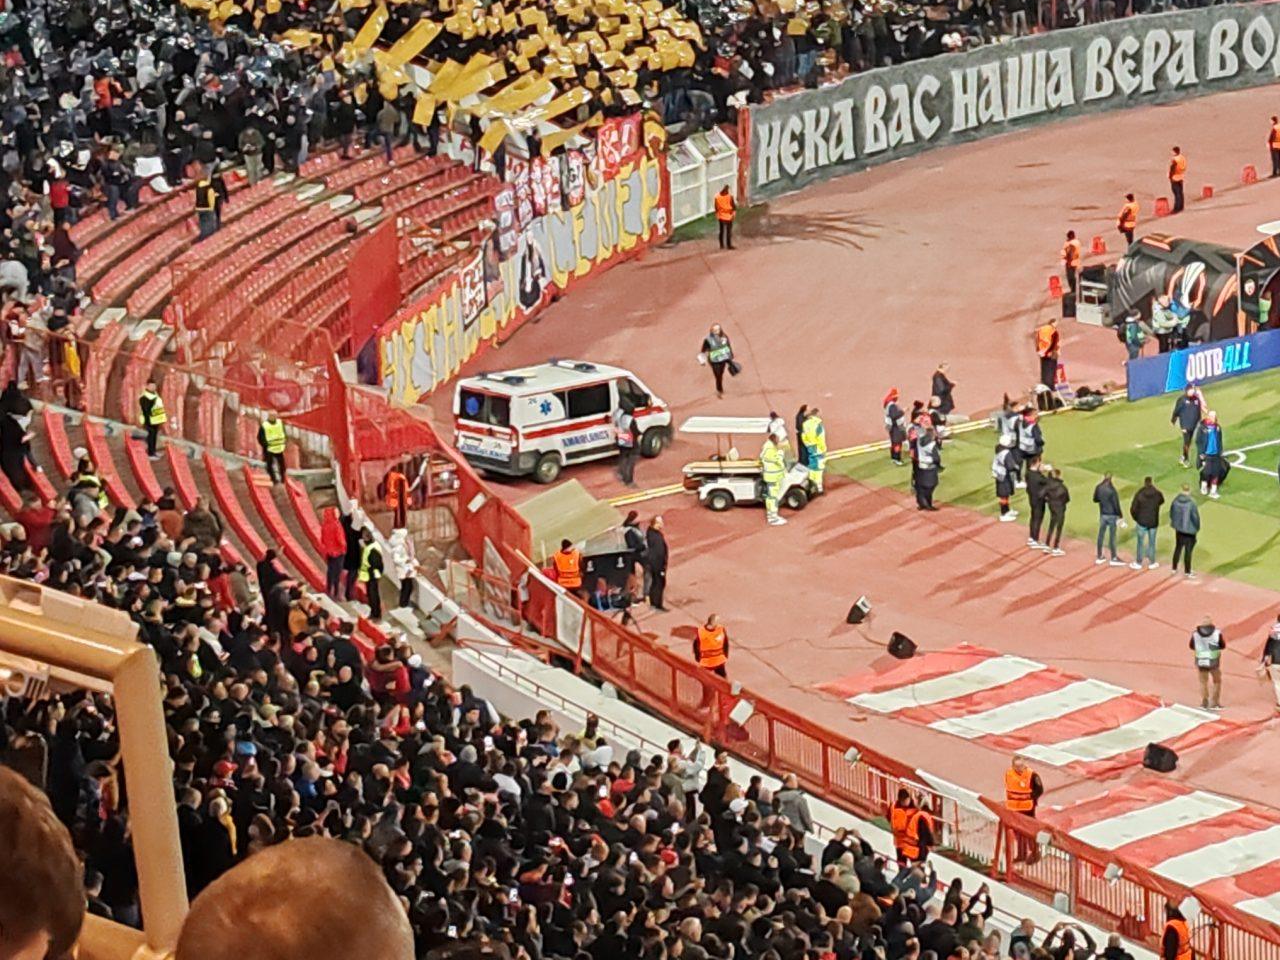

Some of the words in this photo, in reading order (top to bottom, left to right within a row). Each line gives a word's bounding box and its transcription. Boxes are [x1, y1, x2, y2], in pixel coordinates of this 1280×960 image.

[863, 76, 941, 155] ВАС
[951, 47, 1076, 133] НАША
[1084, 29, 1198, 102] ВЕРА
